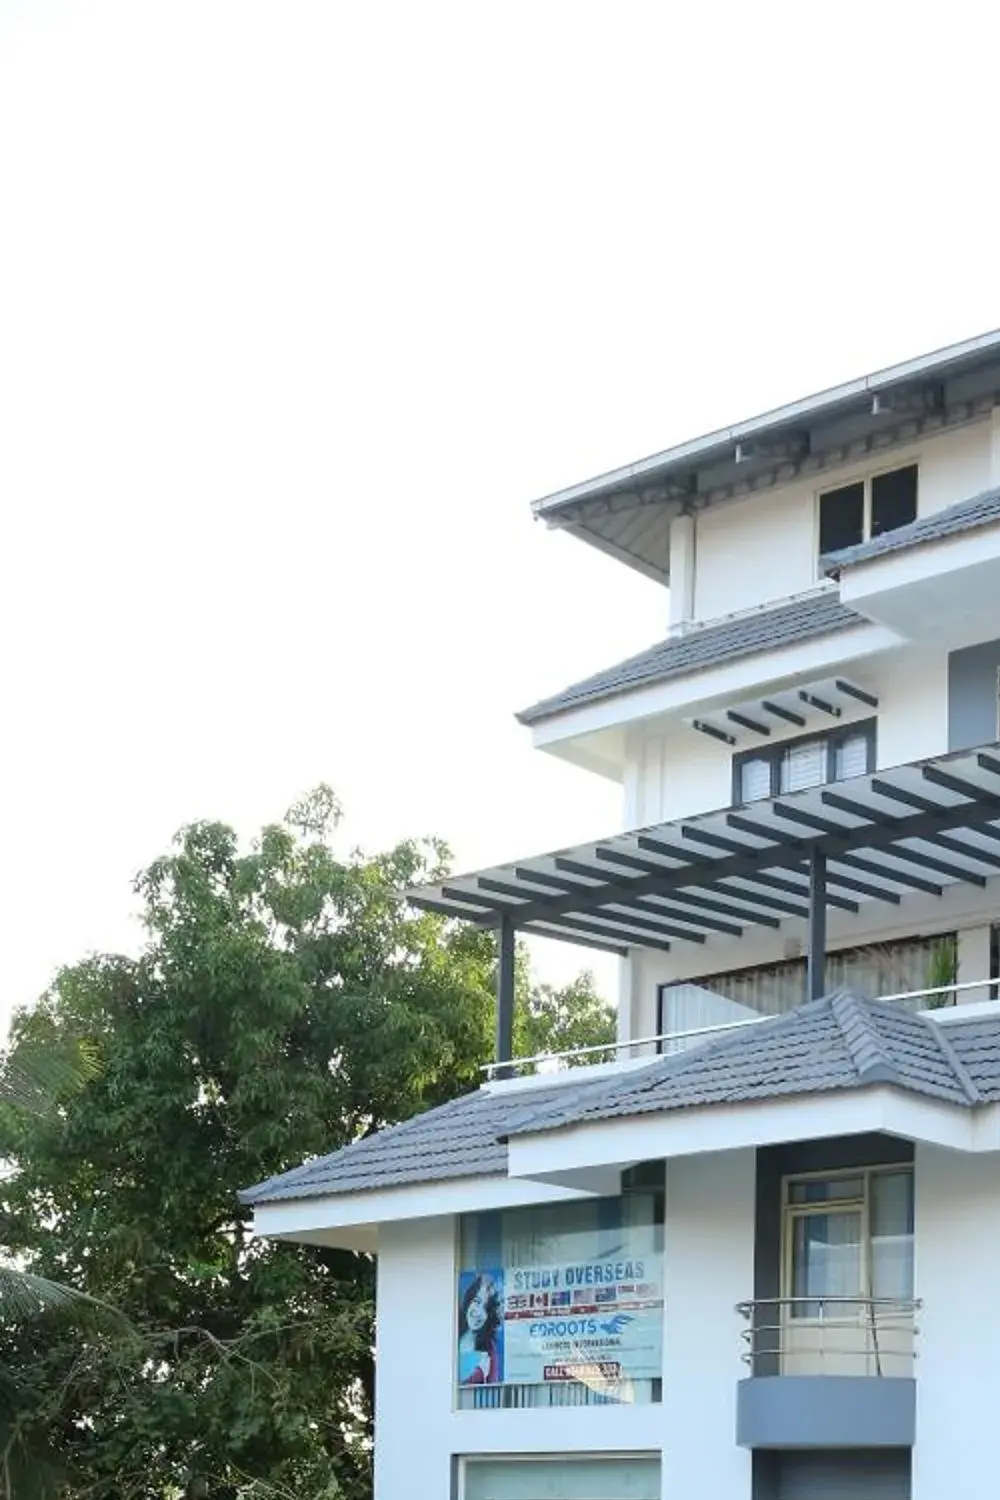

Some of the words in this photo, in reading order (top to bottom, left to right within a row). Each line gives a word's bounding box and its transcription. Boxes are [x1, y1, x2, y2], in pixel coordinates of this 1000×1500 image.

[514, 1270, 560, 1290] STUDY
[565, 1262, 645, 1285] OVERSEAS
[529, 1319, 597, 1337] EDROOTS
